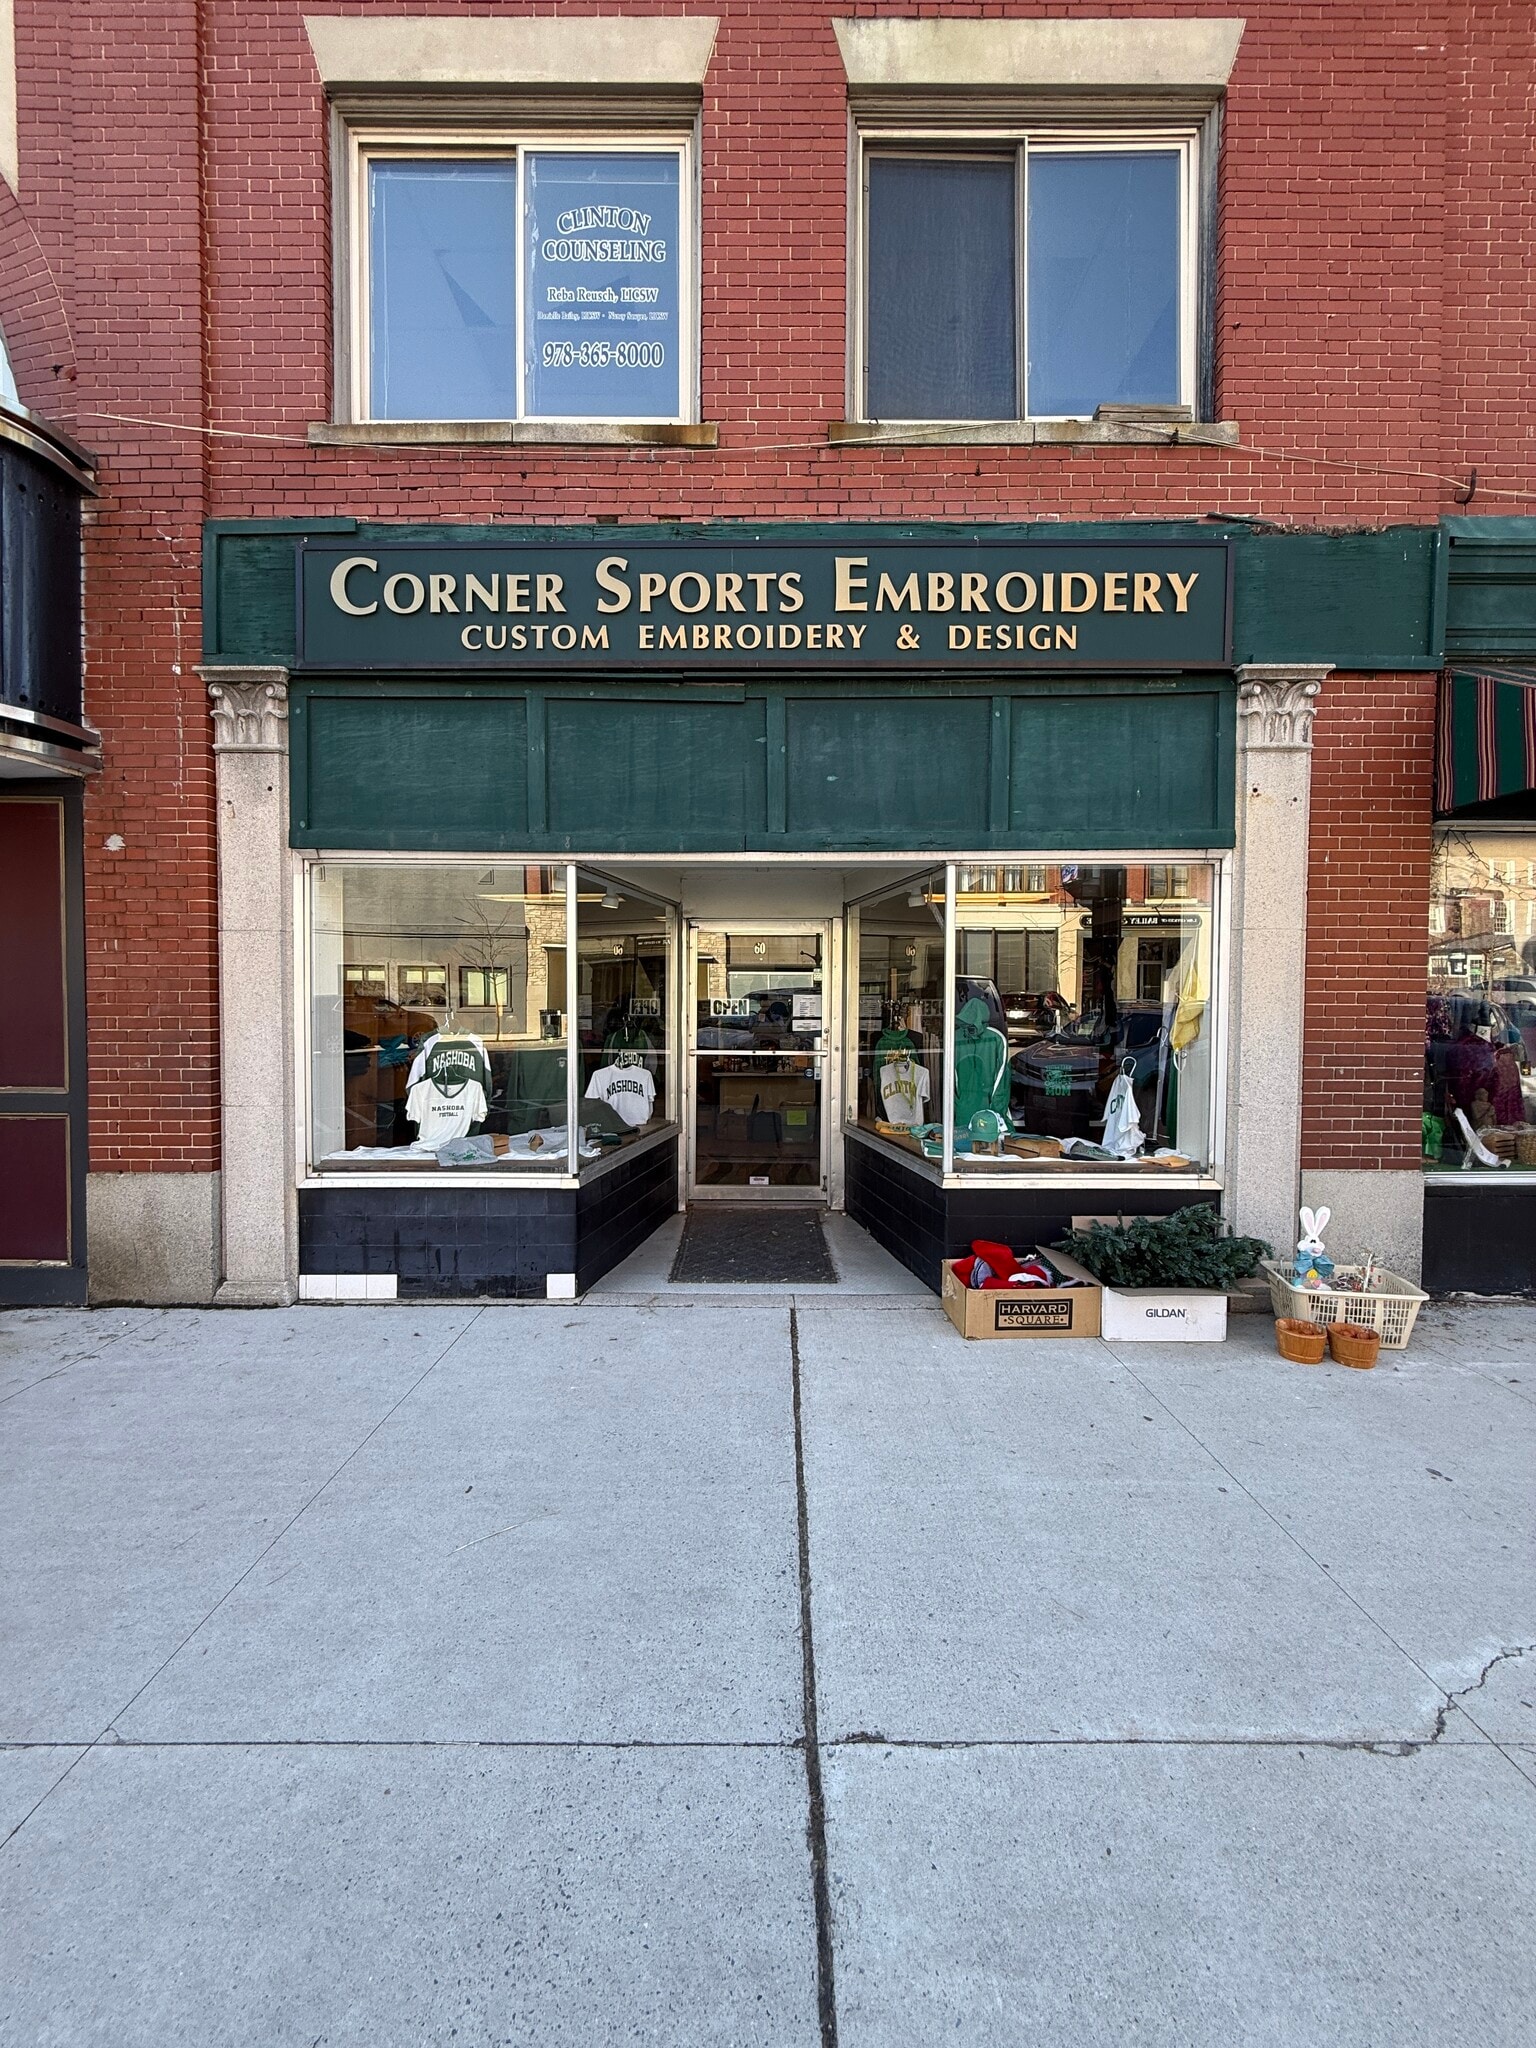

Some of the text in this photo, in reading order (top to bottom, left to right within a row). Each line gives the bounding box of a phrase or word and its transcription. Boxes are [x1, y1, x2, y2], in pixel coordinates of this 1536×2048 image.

[557, 205, 651, 236] CLINTON
[542, 239, 666, 262] COUNSELING
[547, 287, 659, 303] Reba Reusch, LICSW
[542, 341, 664, 367] 978-365-8000
[330, 556, 1199, 616] CORNER SPORTS EMBROIDERY
[461, 624, 1077, 650] CUSTOM EMBROIDERY & DESIGN
[754, 942, 766, 954] 60
[713, 999, 748, 1015] OPEN
[432, 1050, 476, 1072] NASHOBA
[606, 1080, 645, 1099] NASHOBA
[1001, 1304, 1067, 1314] HARVARD
[1145, 1308, 1186, 1318] GILDAN
[1007, 1315, 1060, 1325] SQUARE
